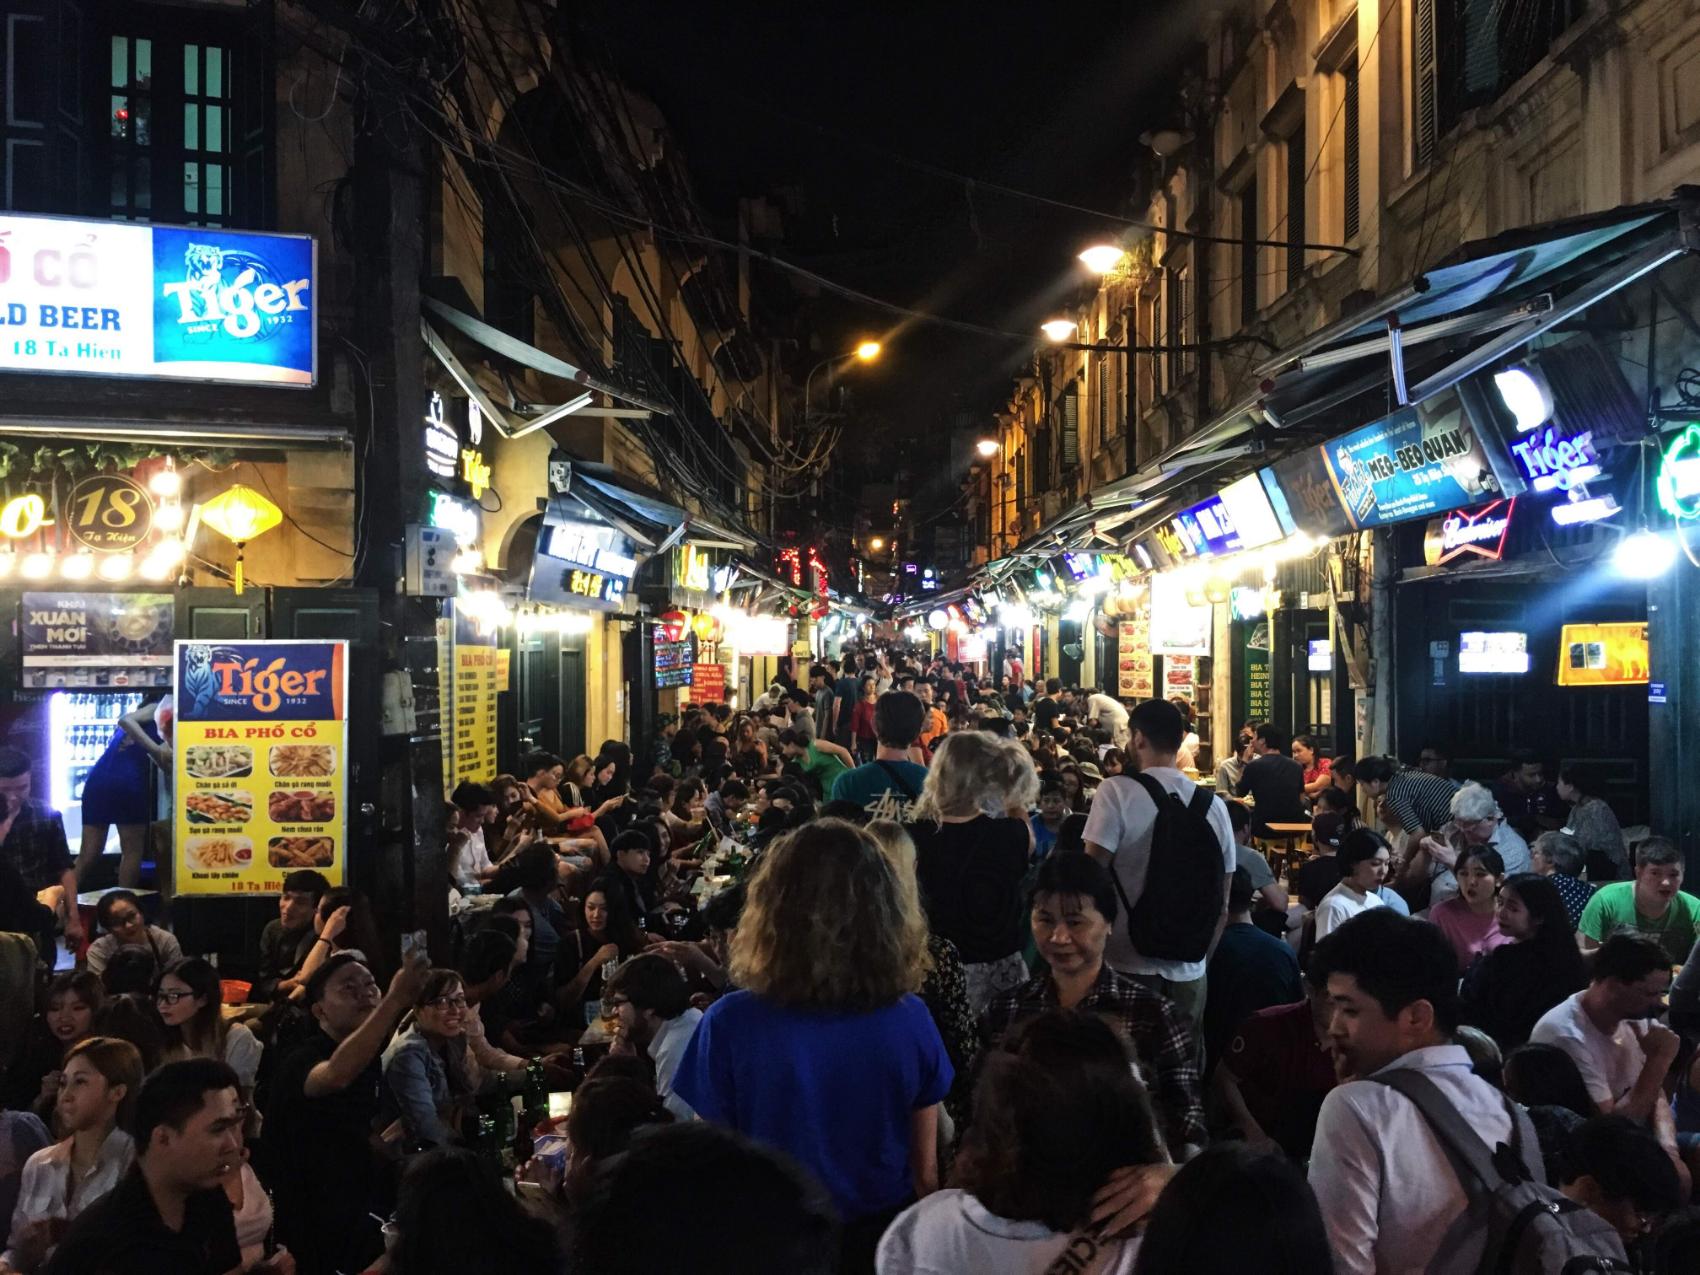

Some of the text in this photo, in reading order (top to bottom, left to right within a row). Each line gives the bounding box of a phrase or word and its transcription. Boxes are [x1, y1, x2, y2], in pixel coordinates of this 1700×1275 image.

[163, 265, 310, 339] Tiger
[40, 304, 121, 331] BEER
[187, 324, 219, 334] SINCE
[13, 339, 37, 356] 18
[1512, 428, 1592, 490] Tiger
[77, 487, 140, 528] 18
[212, 657, 328, 713] Tiger
[285, 697, 307, 705] 1932
[204, 721, 317, 739] BIA PHỐ CỔ
[232, 882, 244, 891] 18
